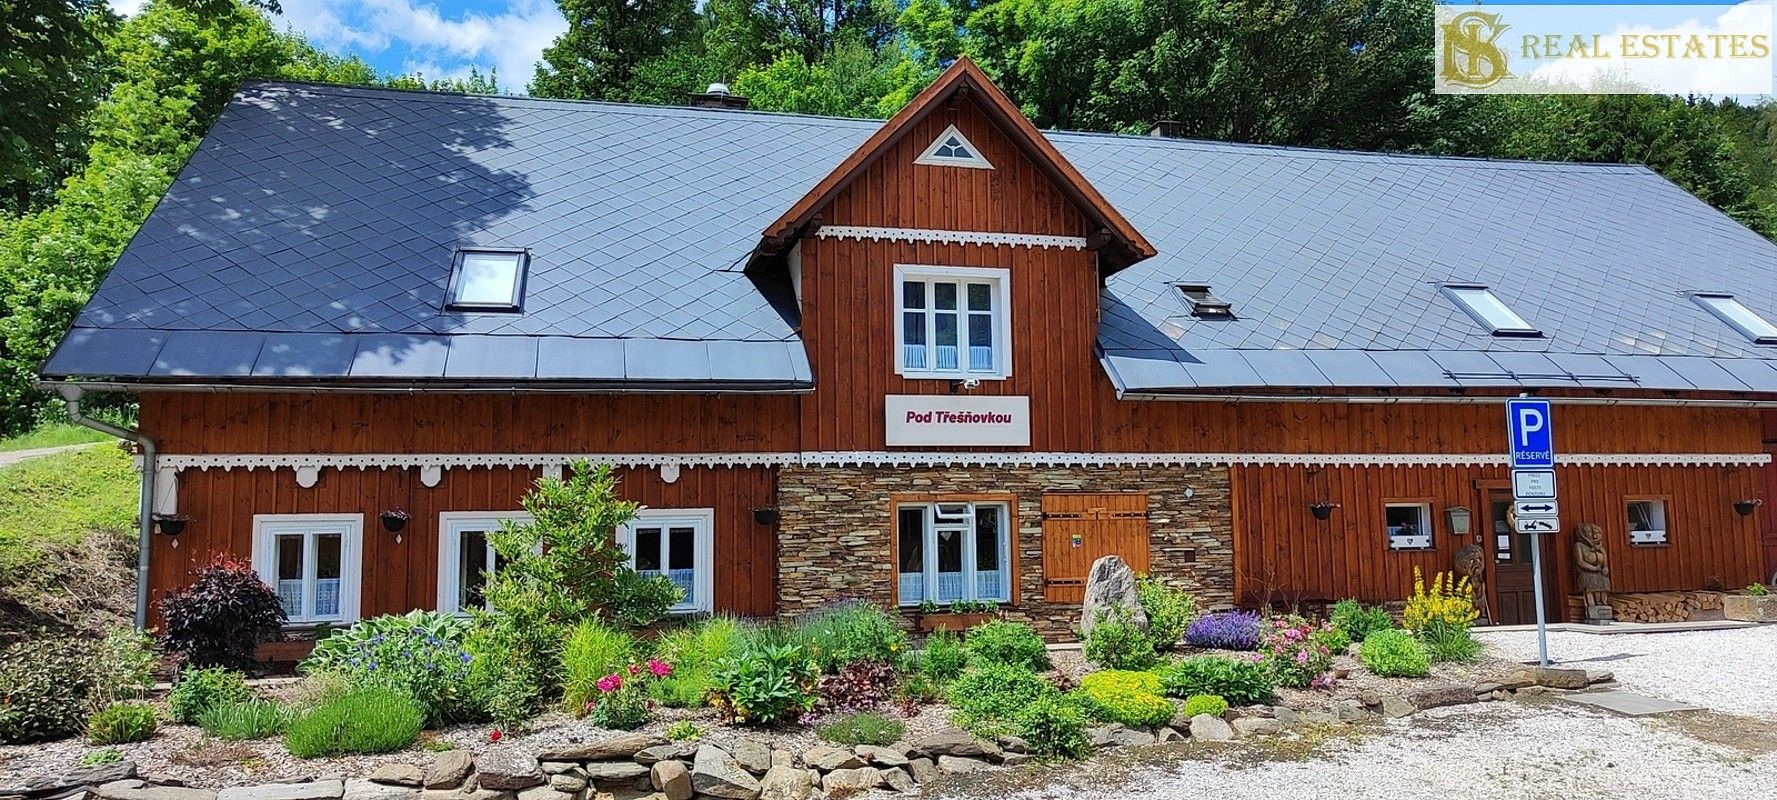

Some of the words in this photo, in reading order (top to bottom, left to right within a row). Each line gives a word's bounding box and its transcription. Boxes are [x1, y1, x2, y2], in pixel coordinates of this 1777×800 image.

[905, 410, 932, 423] Pod
[935, 410, 1012, 423] Třešňovkou
[1519, 408, 1543, 447] P
[1515, 450, 1550, 460] RÉSERVÉ
